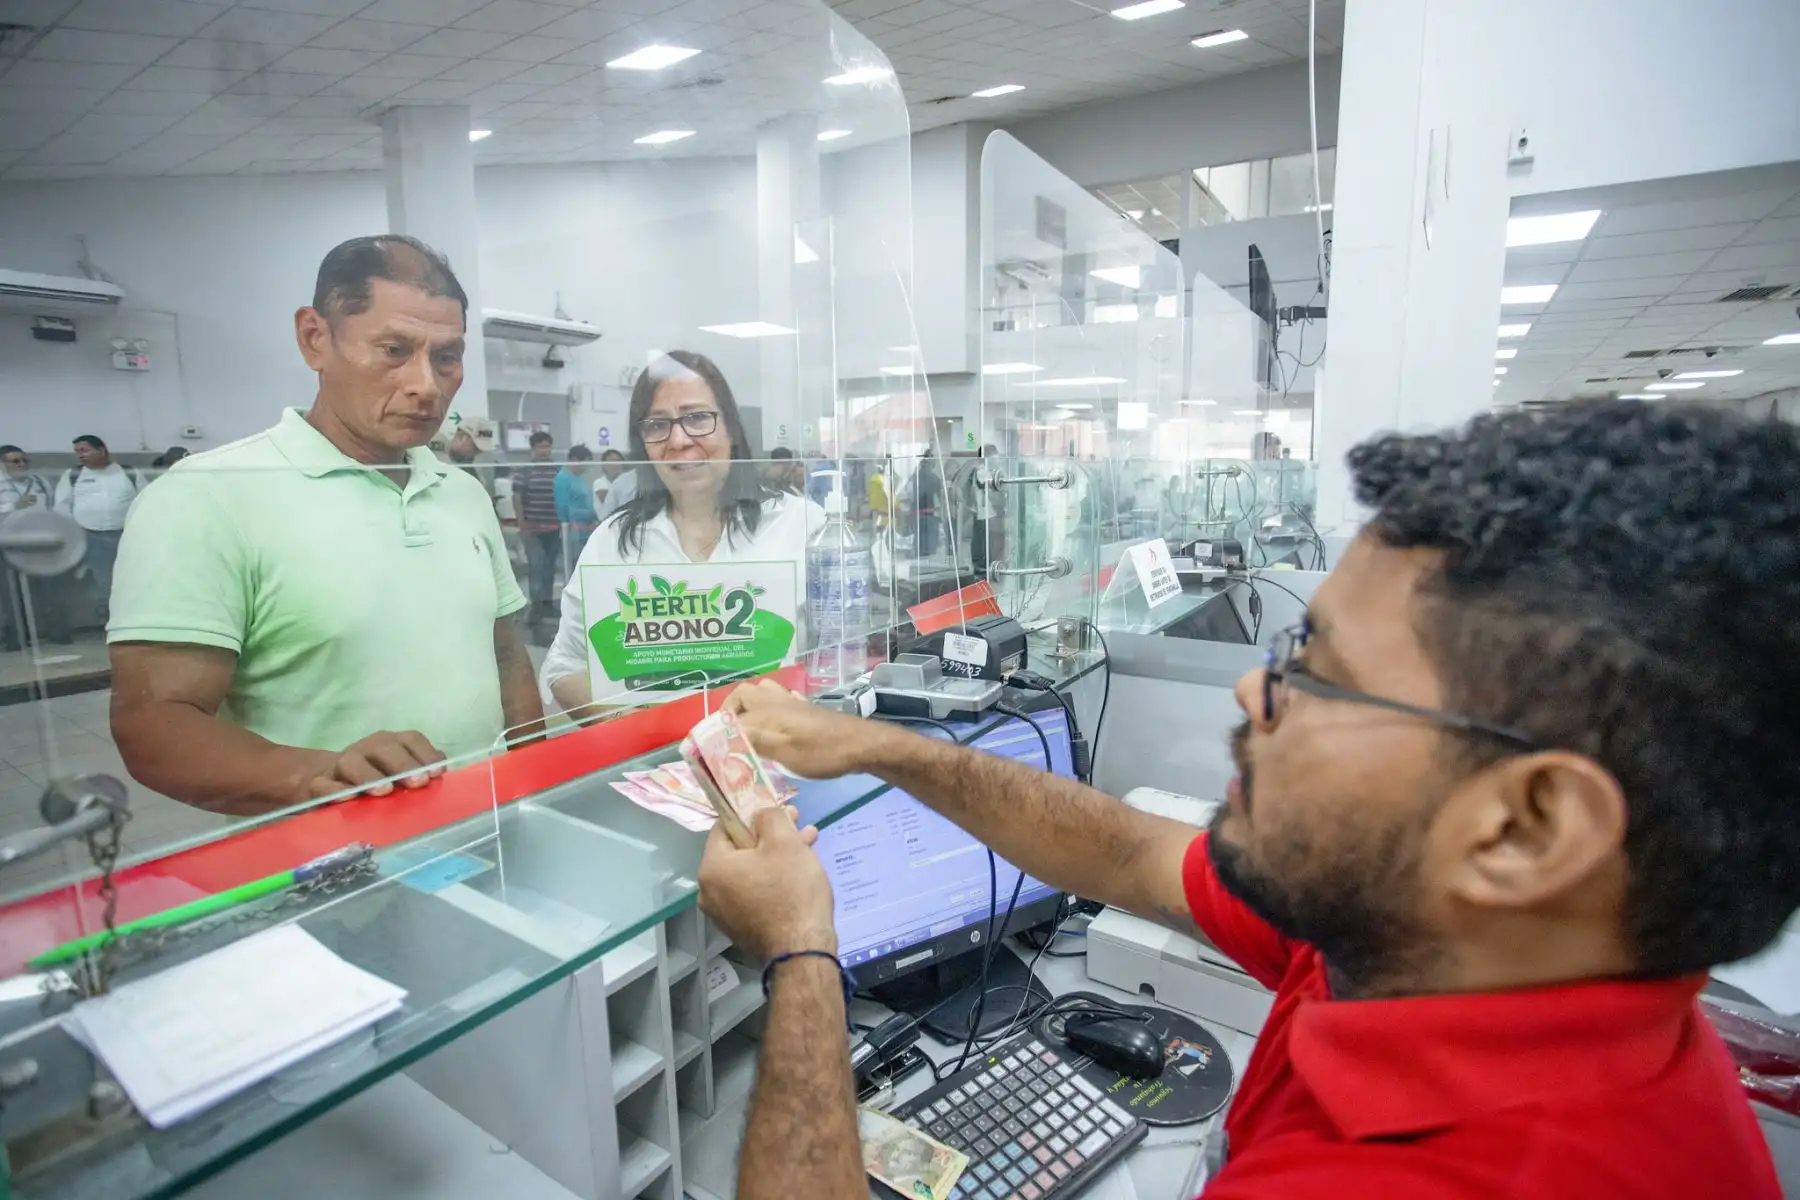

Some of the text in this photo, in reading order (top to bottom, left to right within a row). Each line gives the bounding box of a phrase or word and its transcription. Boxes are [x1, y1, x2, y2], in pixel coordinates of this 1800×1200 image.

[635, 594, 708, 618] FERTI
[724, 589, 754, 636] 2
[625, 617, 724, 644] ABONO
[656, 648, 694, 656] MONETARIO
[694, 645, 731, 654] INDIVIDUAL
[940, 660, 982, 677] 599403
